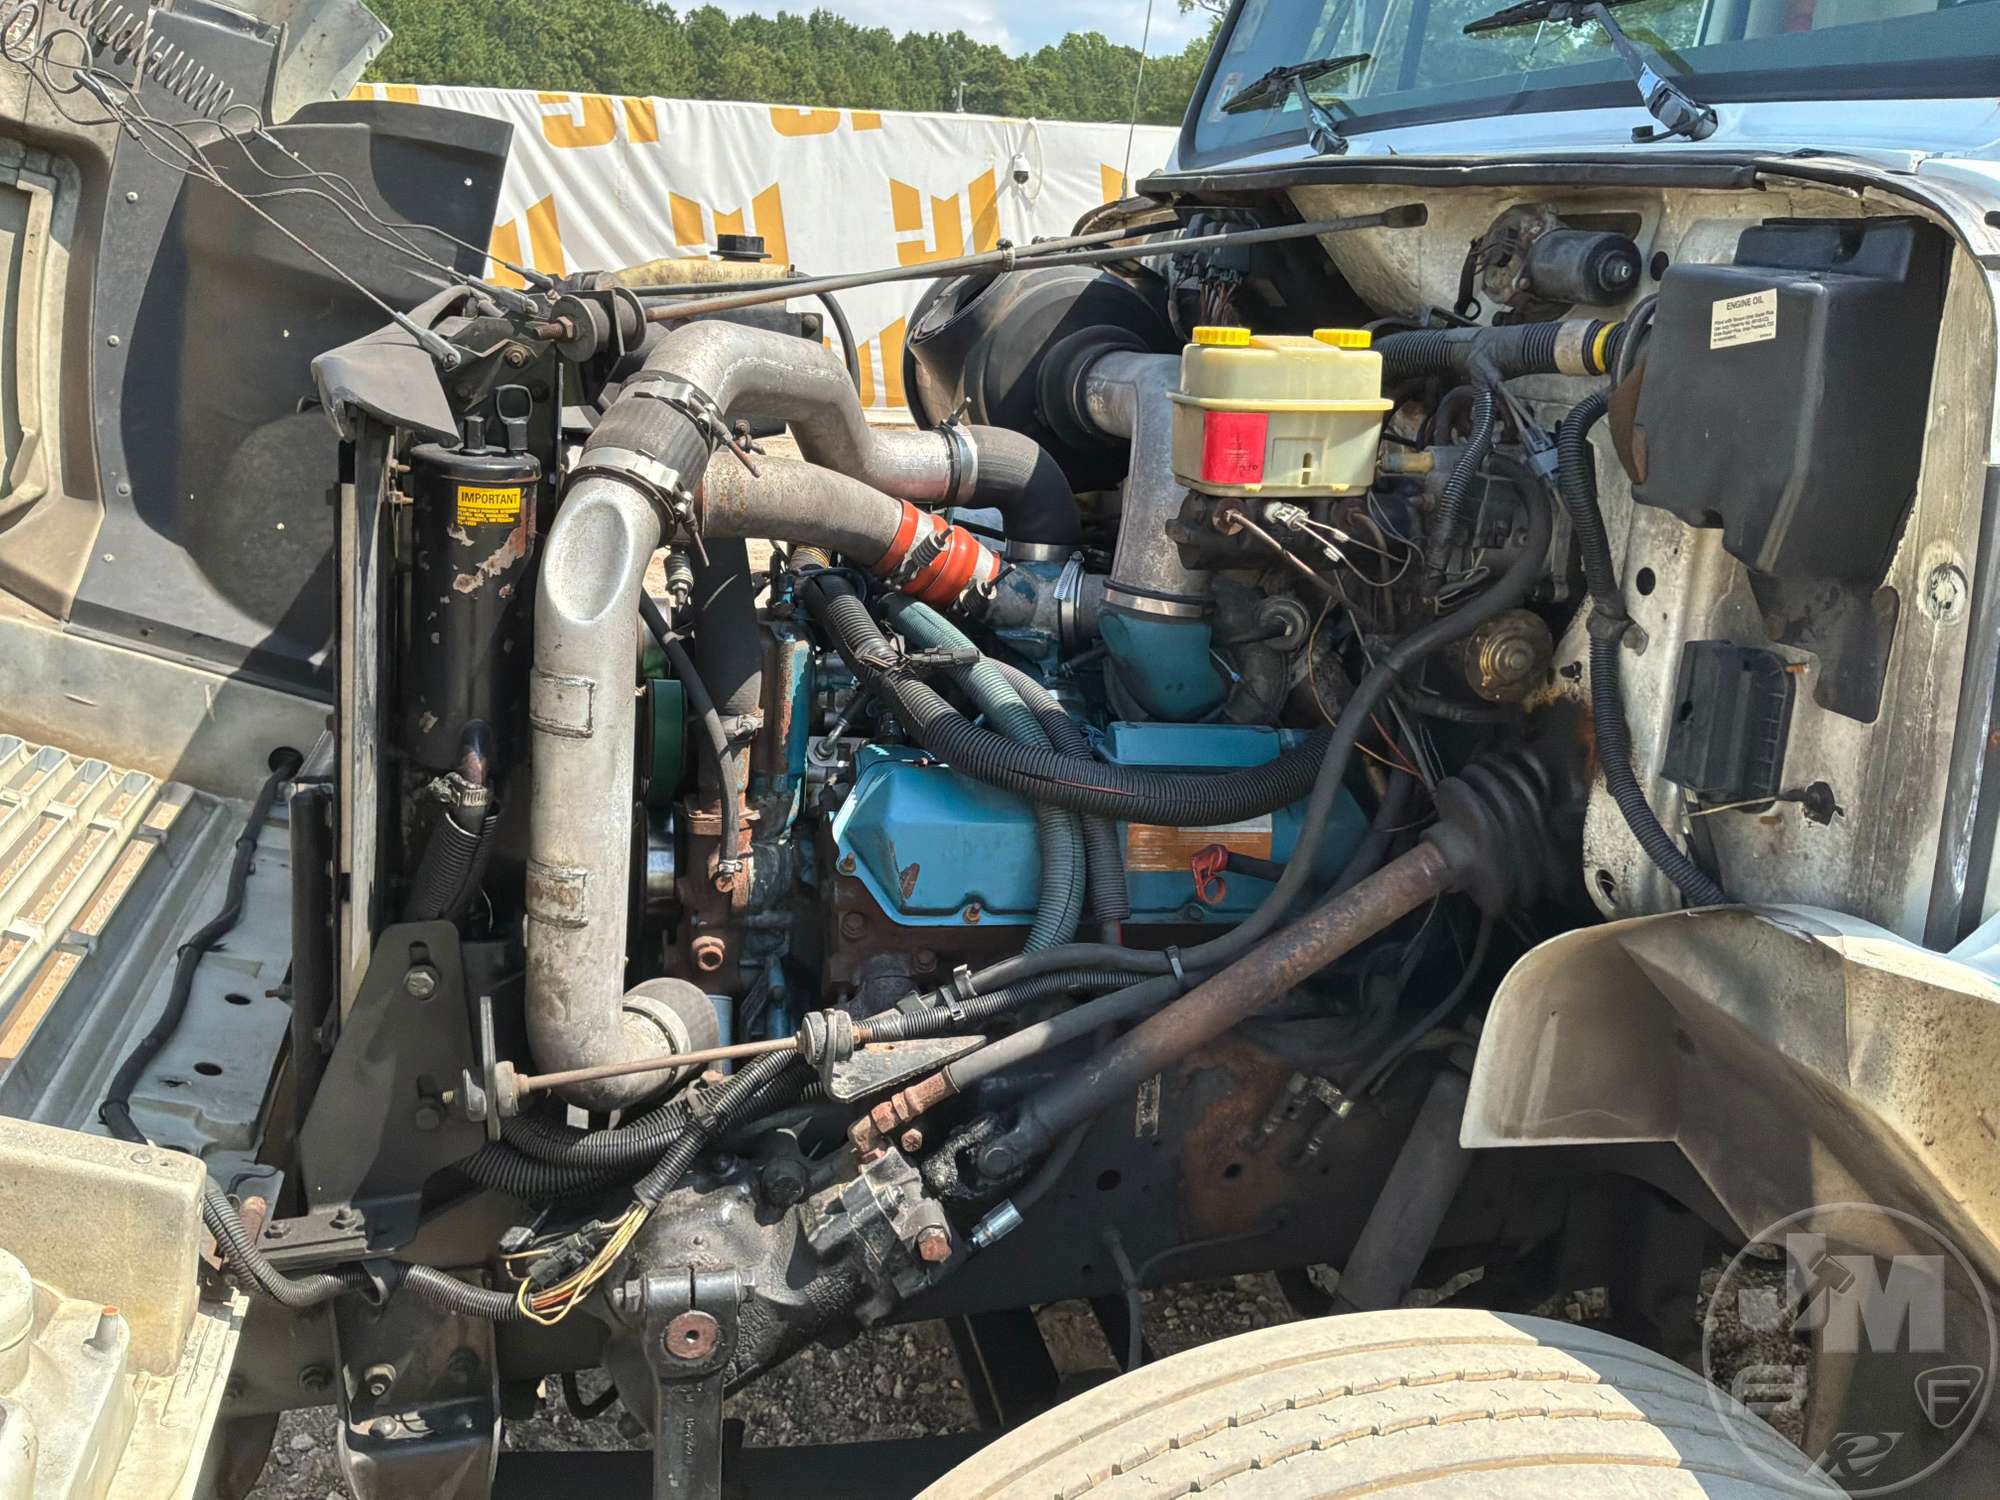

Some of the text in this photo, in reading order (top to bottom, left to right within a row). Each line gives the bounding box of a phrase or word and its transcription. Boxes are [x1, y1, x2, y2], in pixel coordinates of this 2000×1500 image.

[1726, 295, 1764, 311] ENGINE OIL
[460, 491, 518, 505] IMPORTANT
